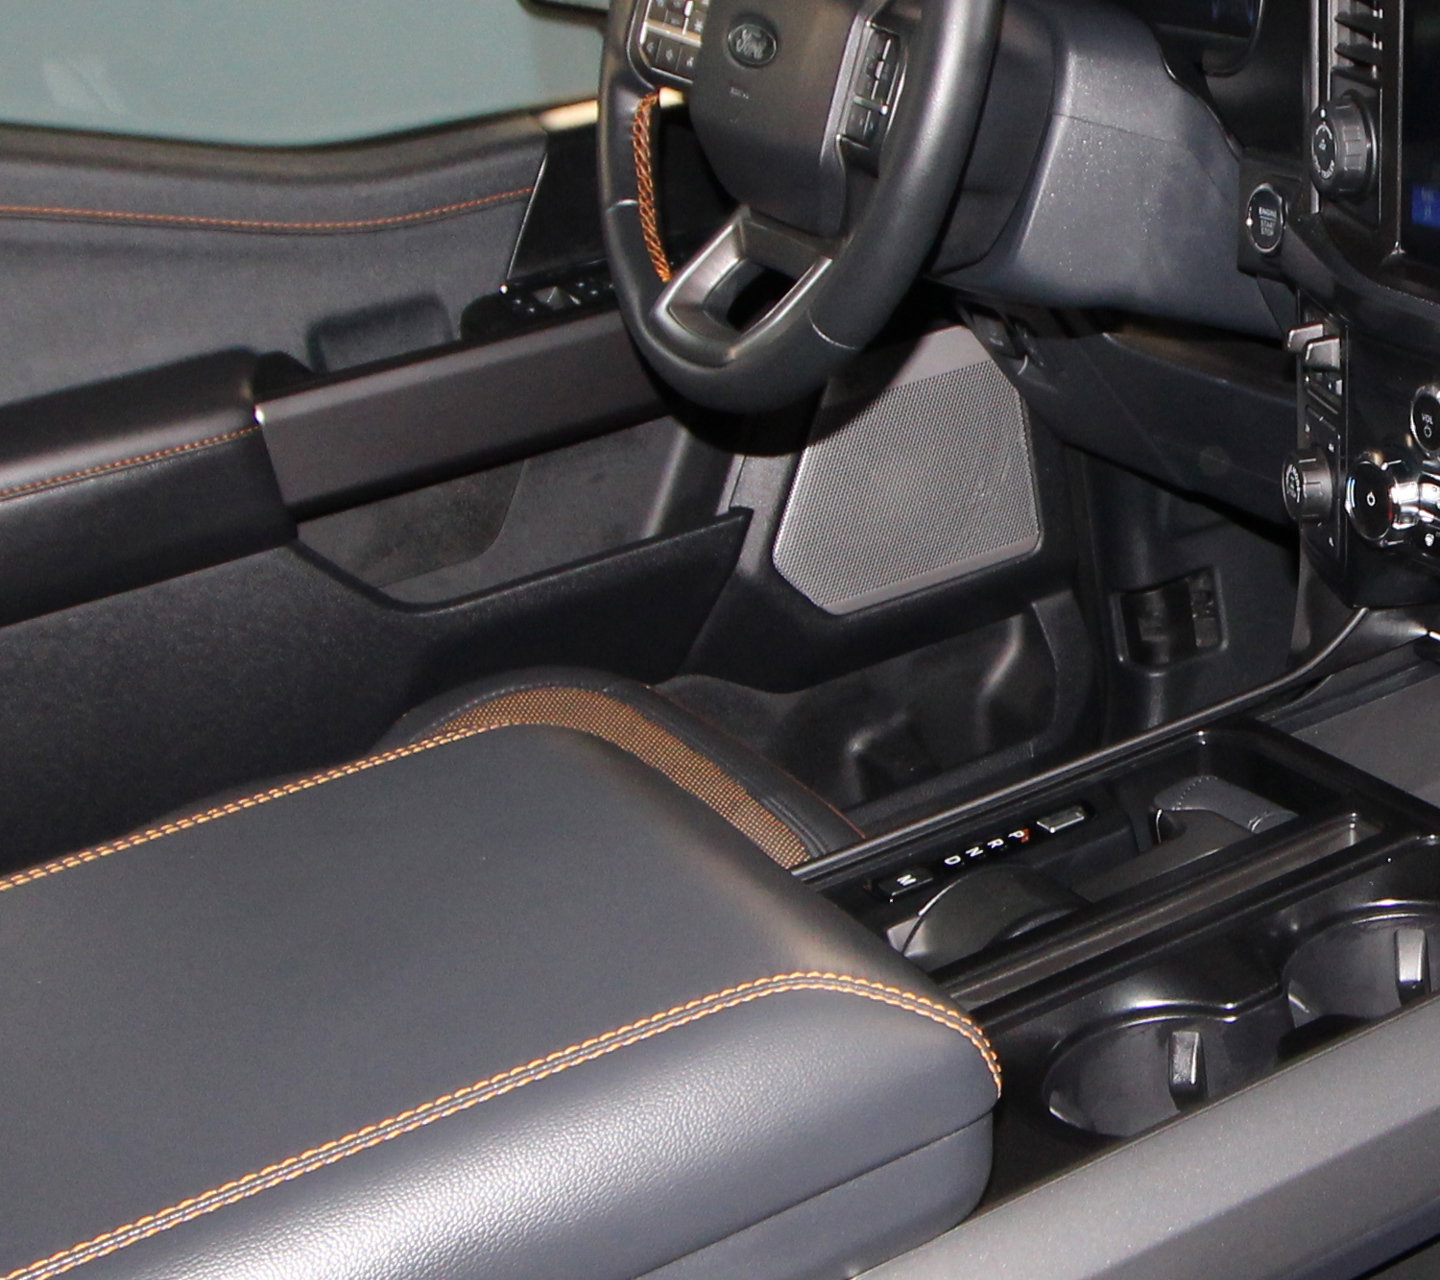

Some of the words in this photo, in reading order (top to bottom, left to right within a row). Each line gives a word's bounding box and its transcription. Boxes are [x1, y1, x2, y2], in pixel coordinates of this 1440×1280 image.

[1008, 830, 1025, 839] P
[987, 838, 1004, 849] R
[965, 846, 984, 857] N
[944, 854, 961, 865] D
